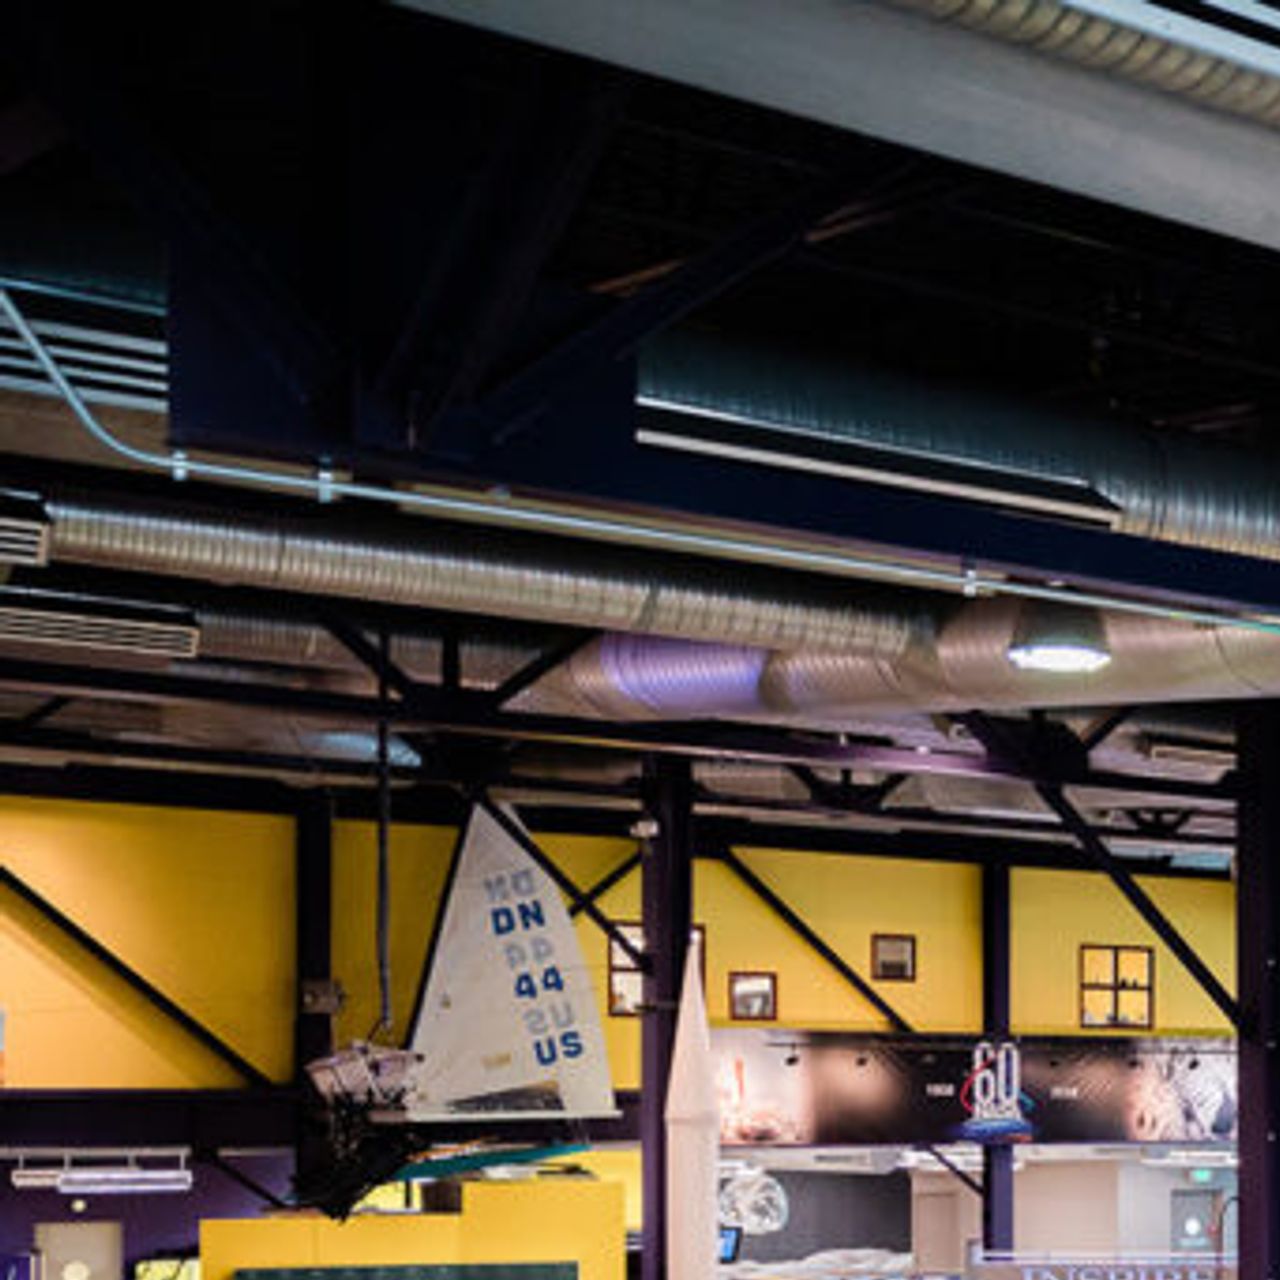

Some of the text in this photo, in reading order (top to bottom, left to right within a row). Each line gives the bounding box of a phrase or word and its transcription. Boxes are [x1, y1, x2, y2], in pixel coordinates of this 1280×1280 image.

[492, 901, 545, 935] DN
[515, 965, 564, 999] 44
[534, 1031, 584, 1066] US
